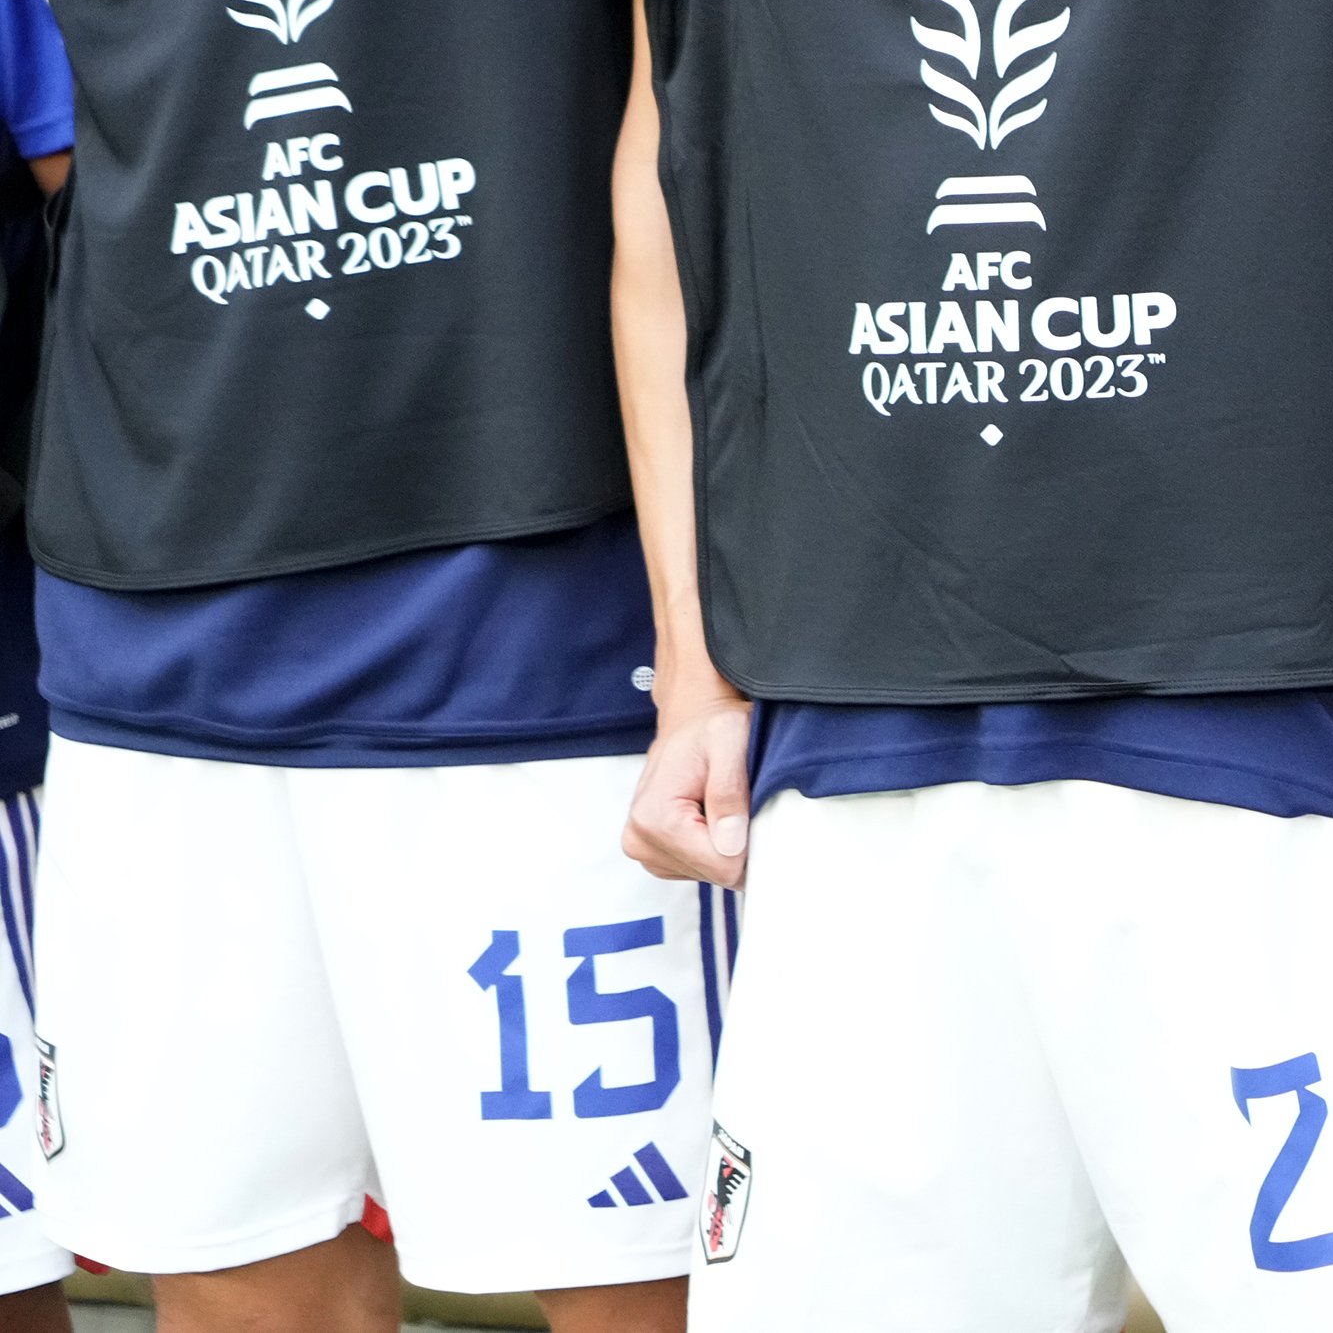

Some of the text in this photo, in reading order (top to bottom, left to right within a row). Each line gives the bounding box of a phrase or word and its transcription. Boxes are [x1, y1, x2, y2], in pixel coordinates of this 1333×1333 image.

[261, 132, 344, 181] AFC
[169, 157, 477, 255] ASIAN CUP
[190, 238, 333, 305] QATAR
[941, 250, 1033, 292] AFC
[848, 291, 1178, 355] ASIAN CUP
[862, 359, 1009, 417] QATAR
[467, 915, 682, 1120] 15
